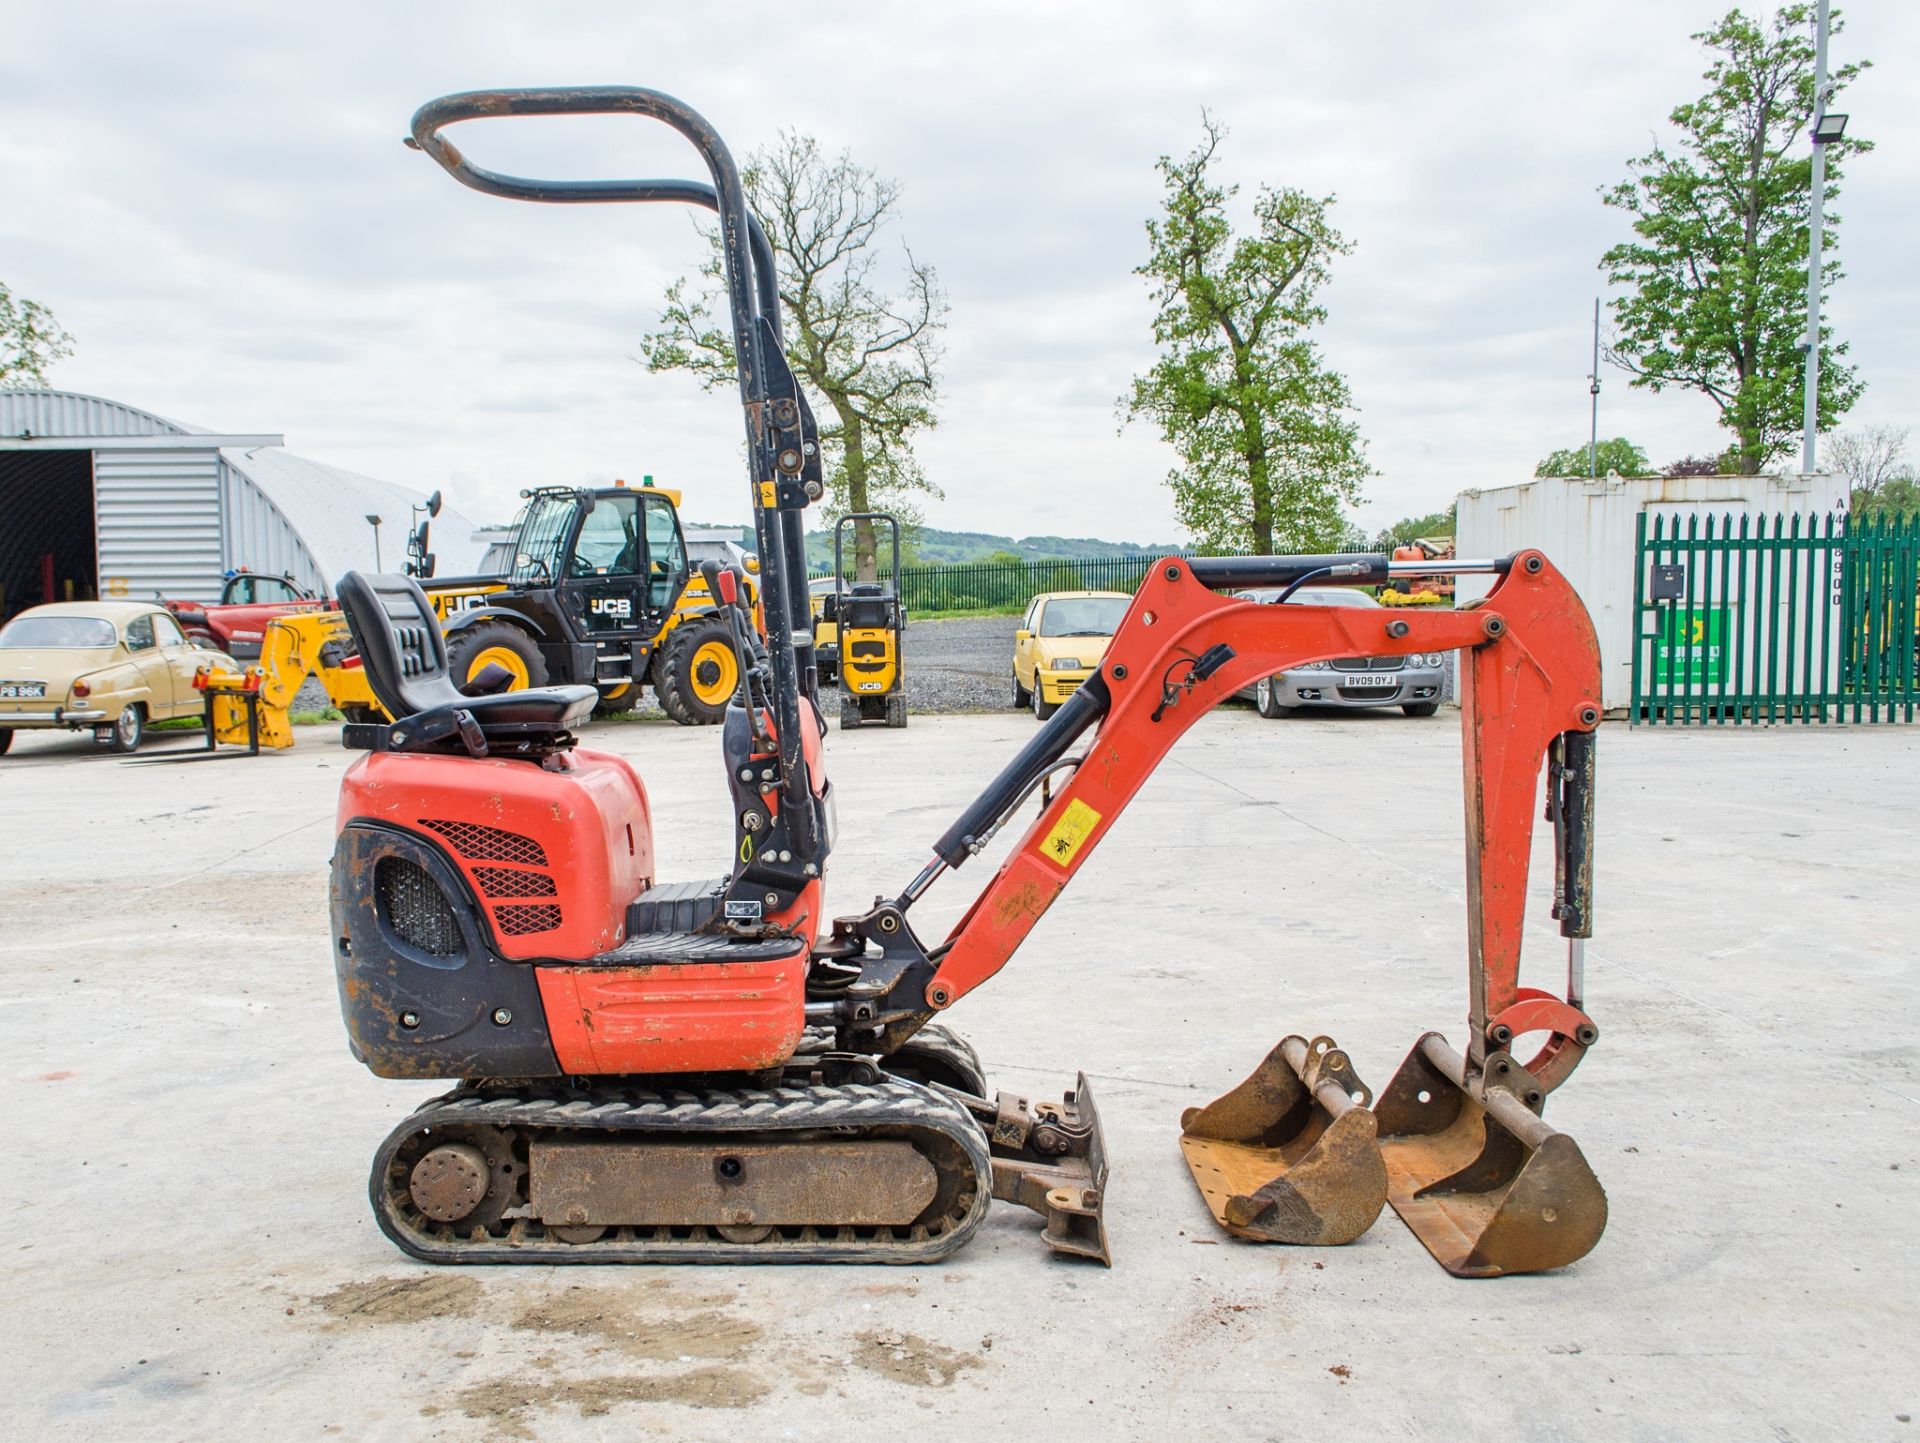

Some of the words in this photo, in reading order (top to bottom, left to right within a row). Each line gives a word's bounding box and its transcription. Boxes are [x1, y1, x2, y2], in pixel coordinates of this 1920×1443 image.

[445, 594, 489, 617] JC
[591, 598, 632, 614] JCB
[858, 681, 882, 690] JCB
[1349, 675, 1374, 686] BV09
[18, 686, 43, 697] 96K
